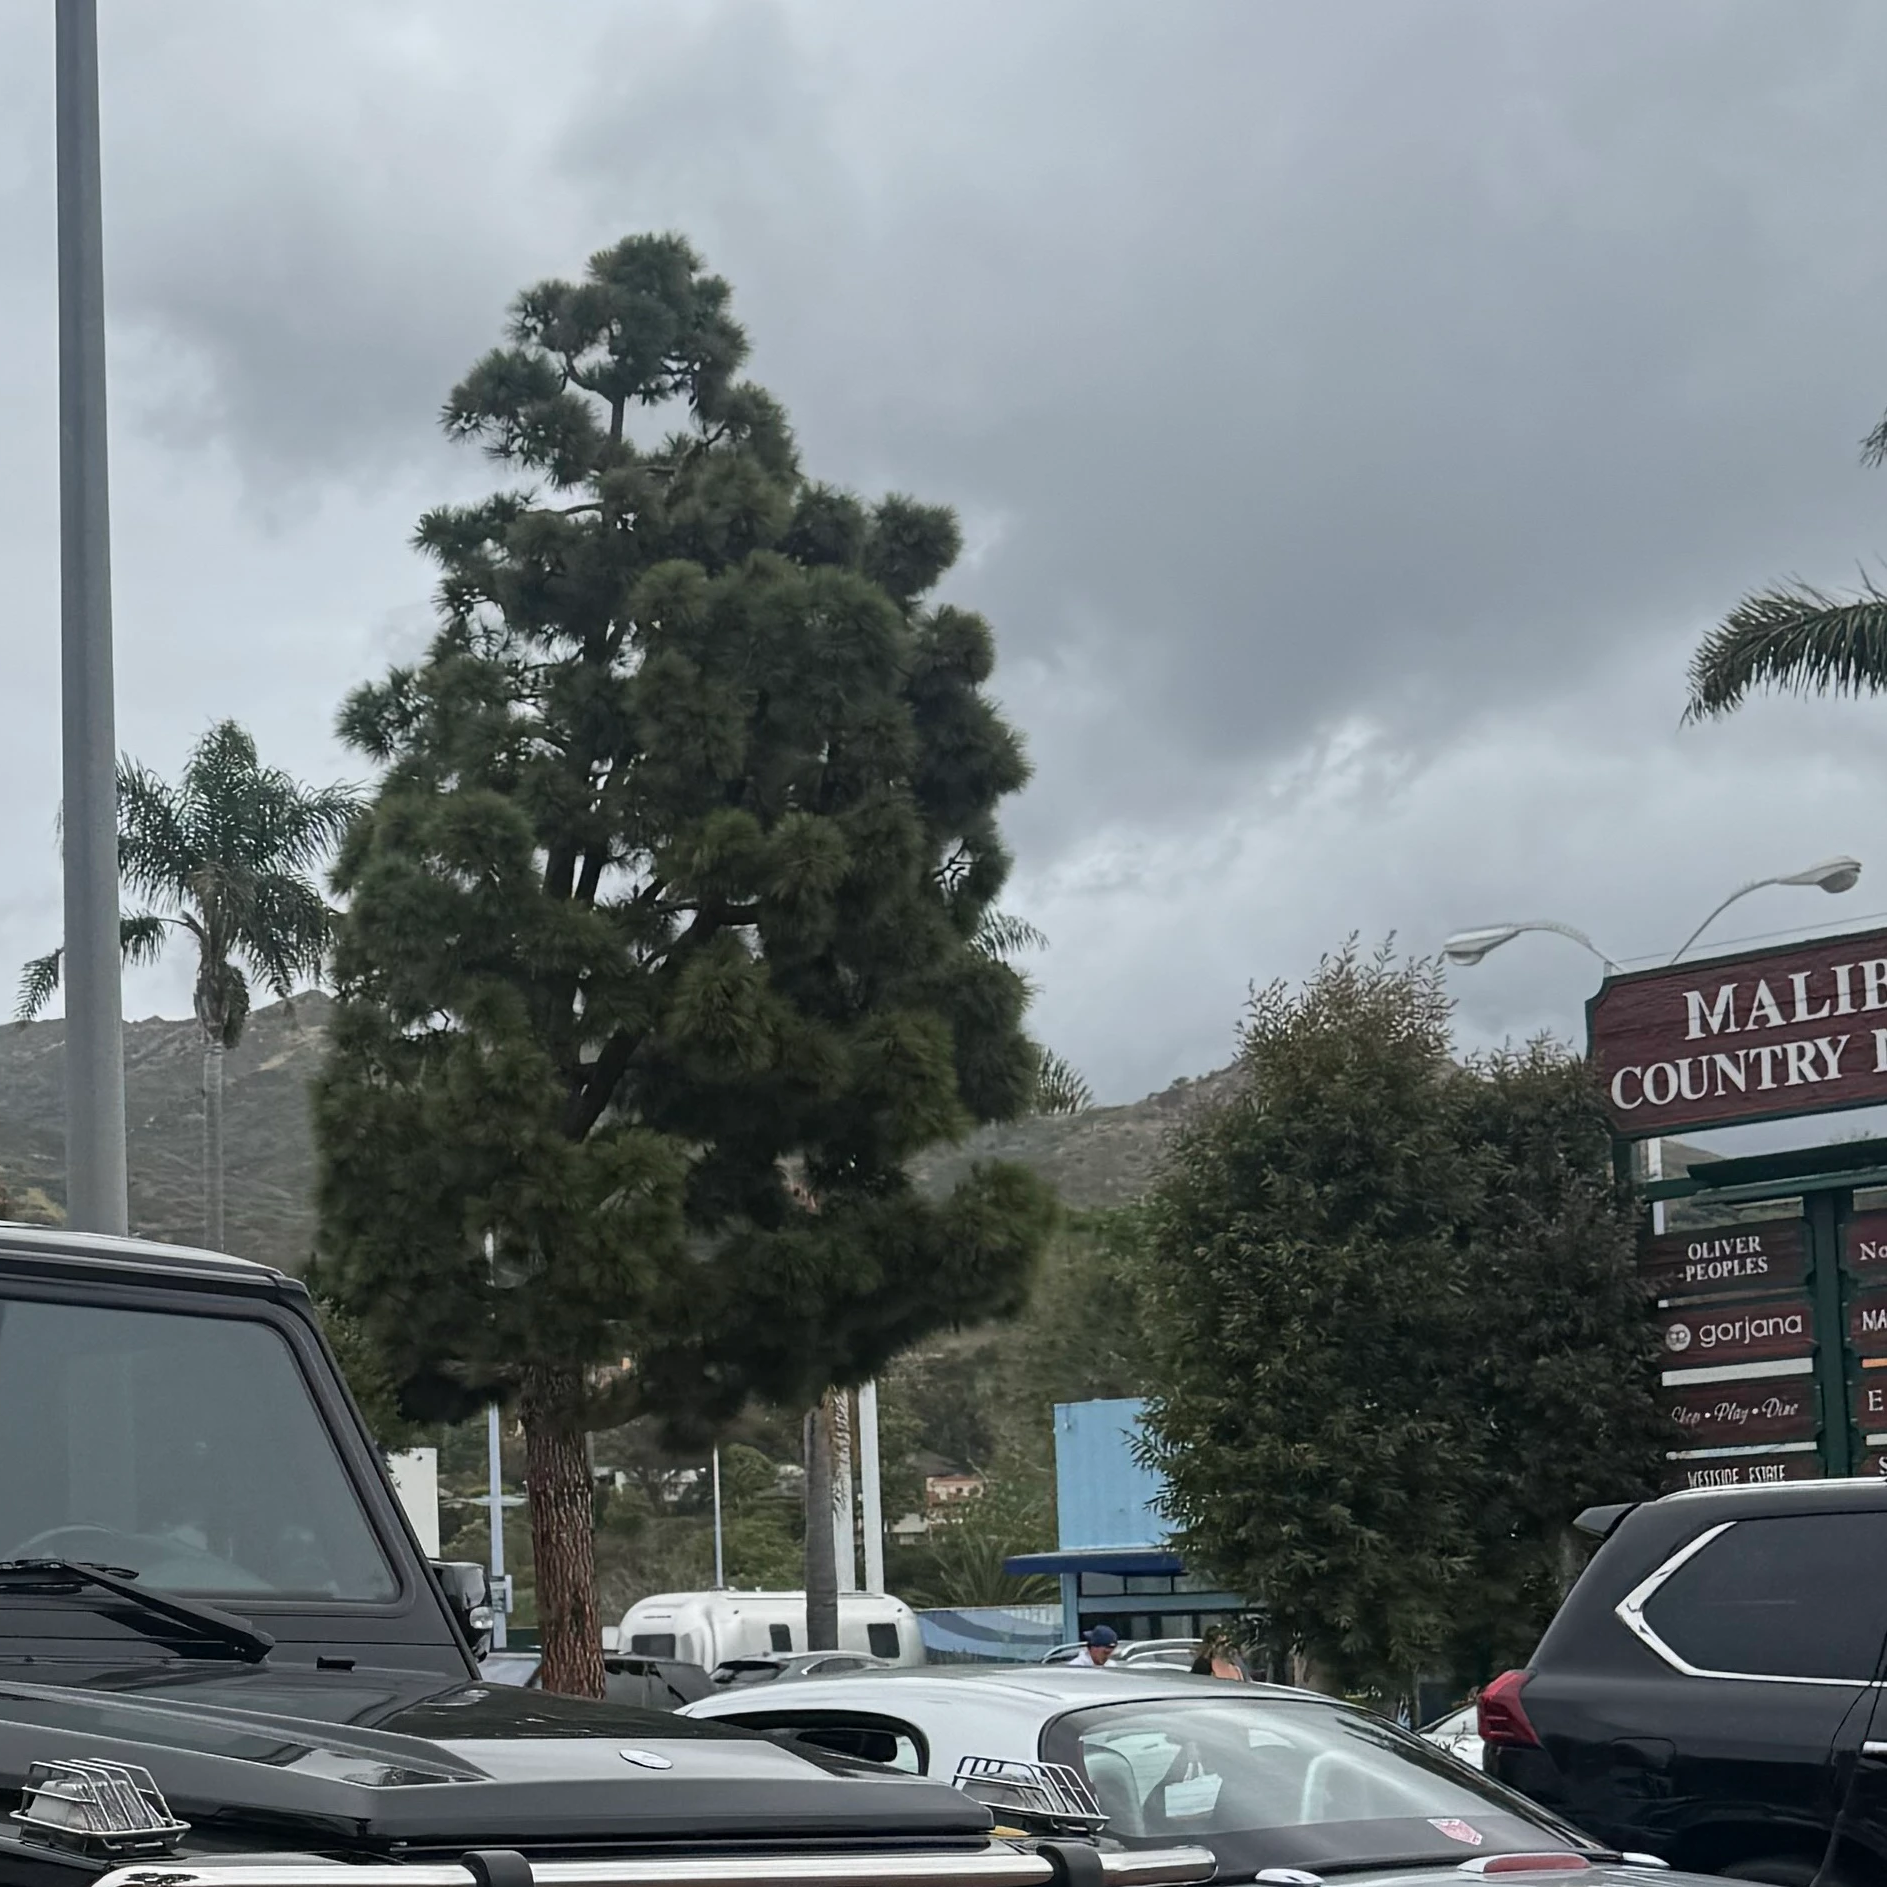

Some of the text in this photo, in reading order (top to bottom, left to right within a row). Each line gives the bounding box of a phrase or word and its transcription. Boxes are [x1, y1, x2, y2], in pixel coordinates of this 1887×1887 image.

[1611, 1034, 1851, 1110] COUNTRY
[1688, 1236, 1762, 1260] OLIVER
[1686, 1256, 1768, 1282] PEOPLES
[1699, 1315, 1802, 1348] gorjana
[1714, 1402, 1749, 1425] Play
[1687, 1468, 1739, 1488] WESTSIDE
